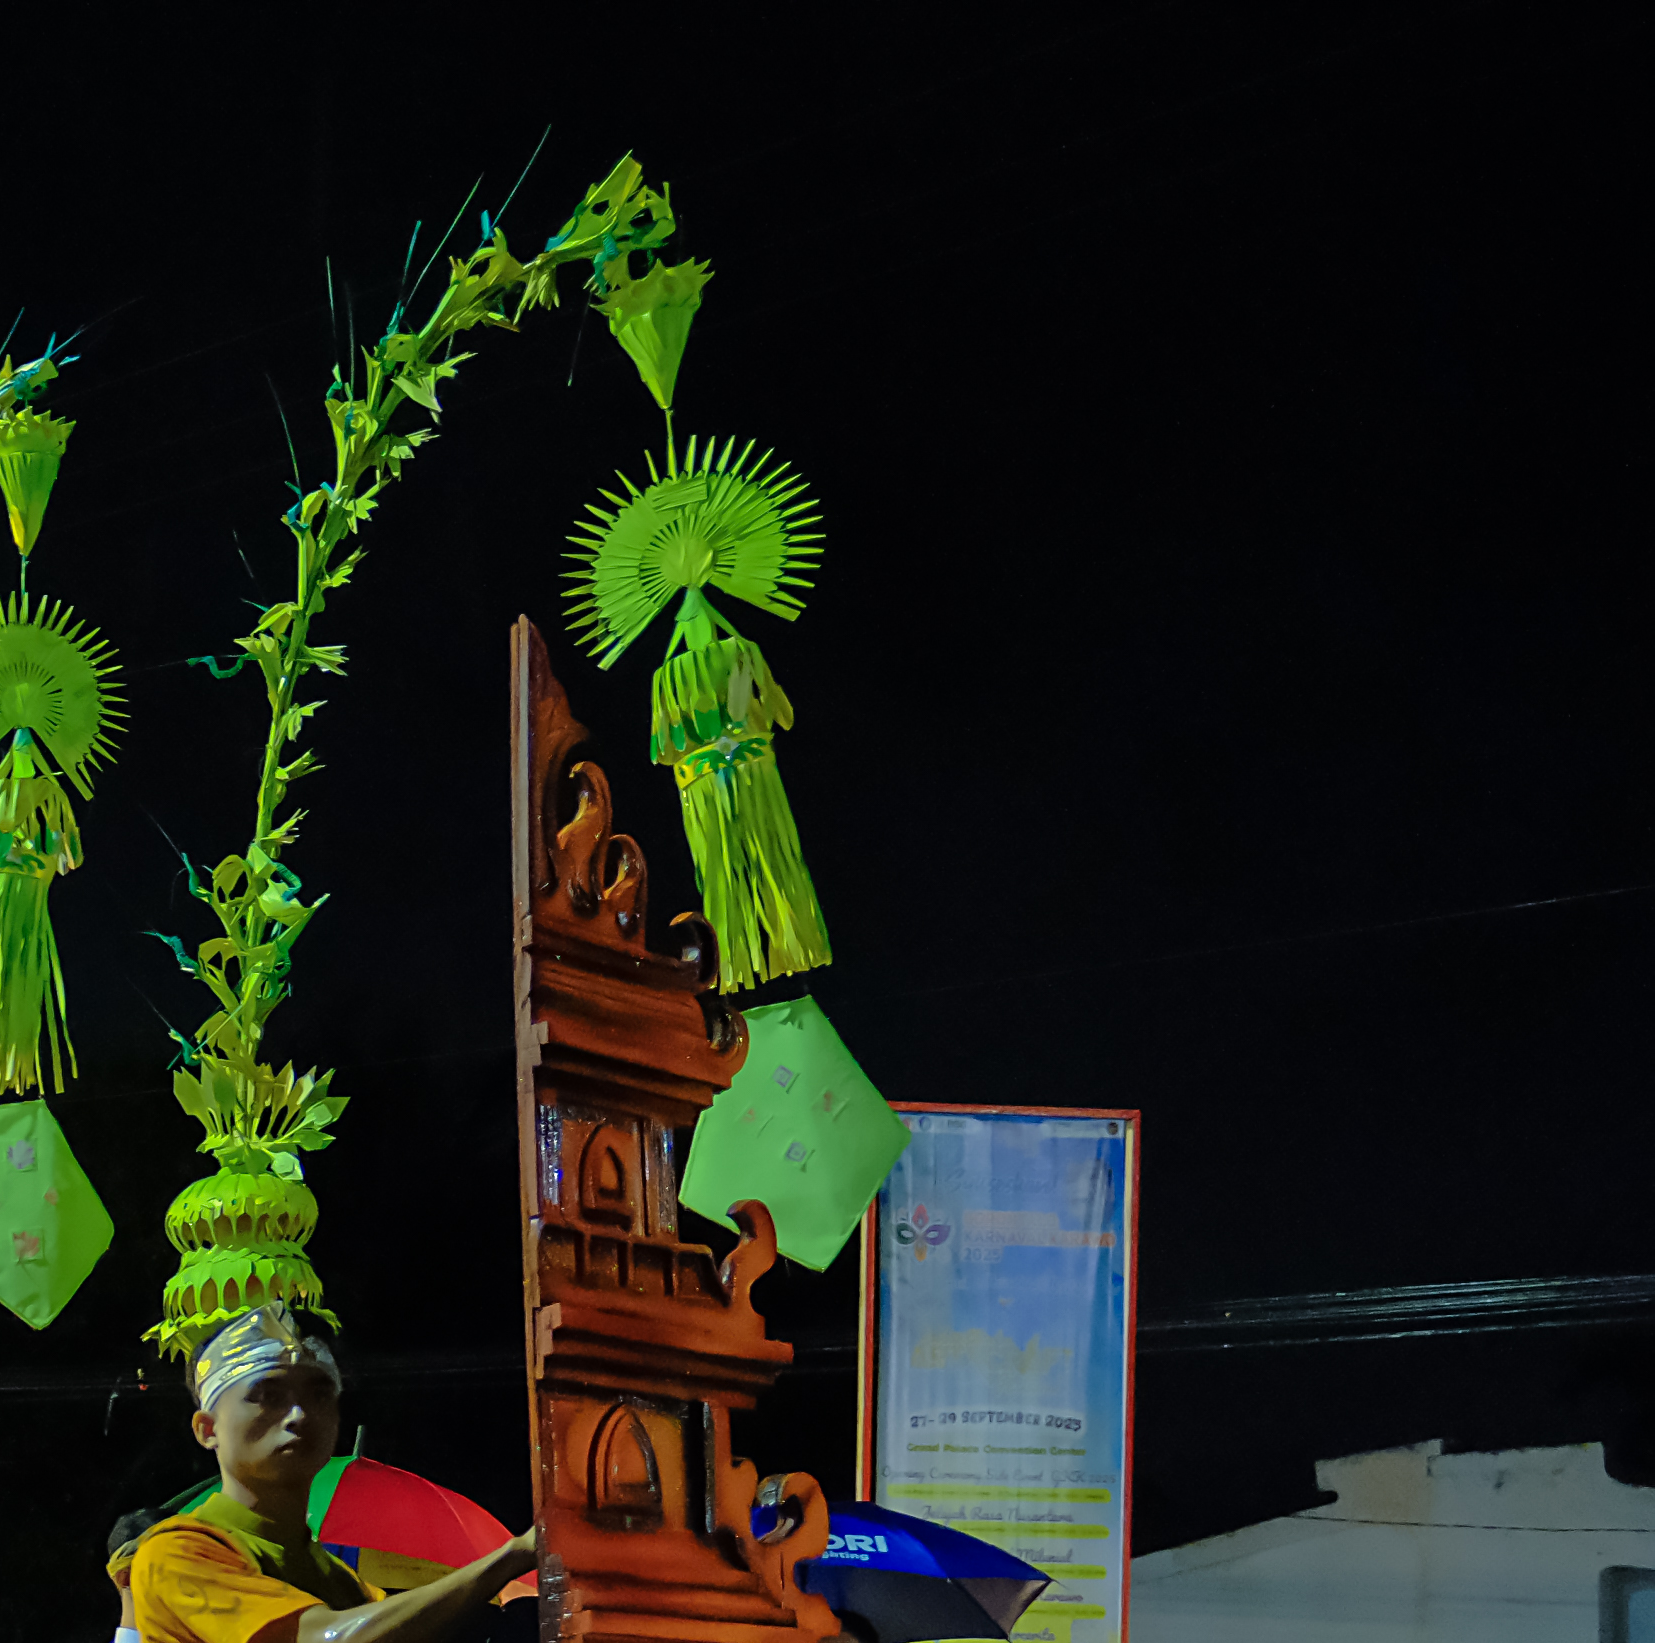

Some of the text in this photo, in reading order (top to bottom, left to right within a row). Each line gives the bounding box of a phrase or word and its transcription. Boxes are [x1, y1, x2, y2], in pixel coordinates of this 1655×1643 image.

[962, 1411, 1040, 1426] SEPTEMBER
[827, 1534, 888, 1553] ORI
[821, 1551, 870, 1562] ghting
